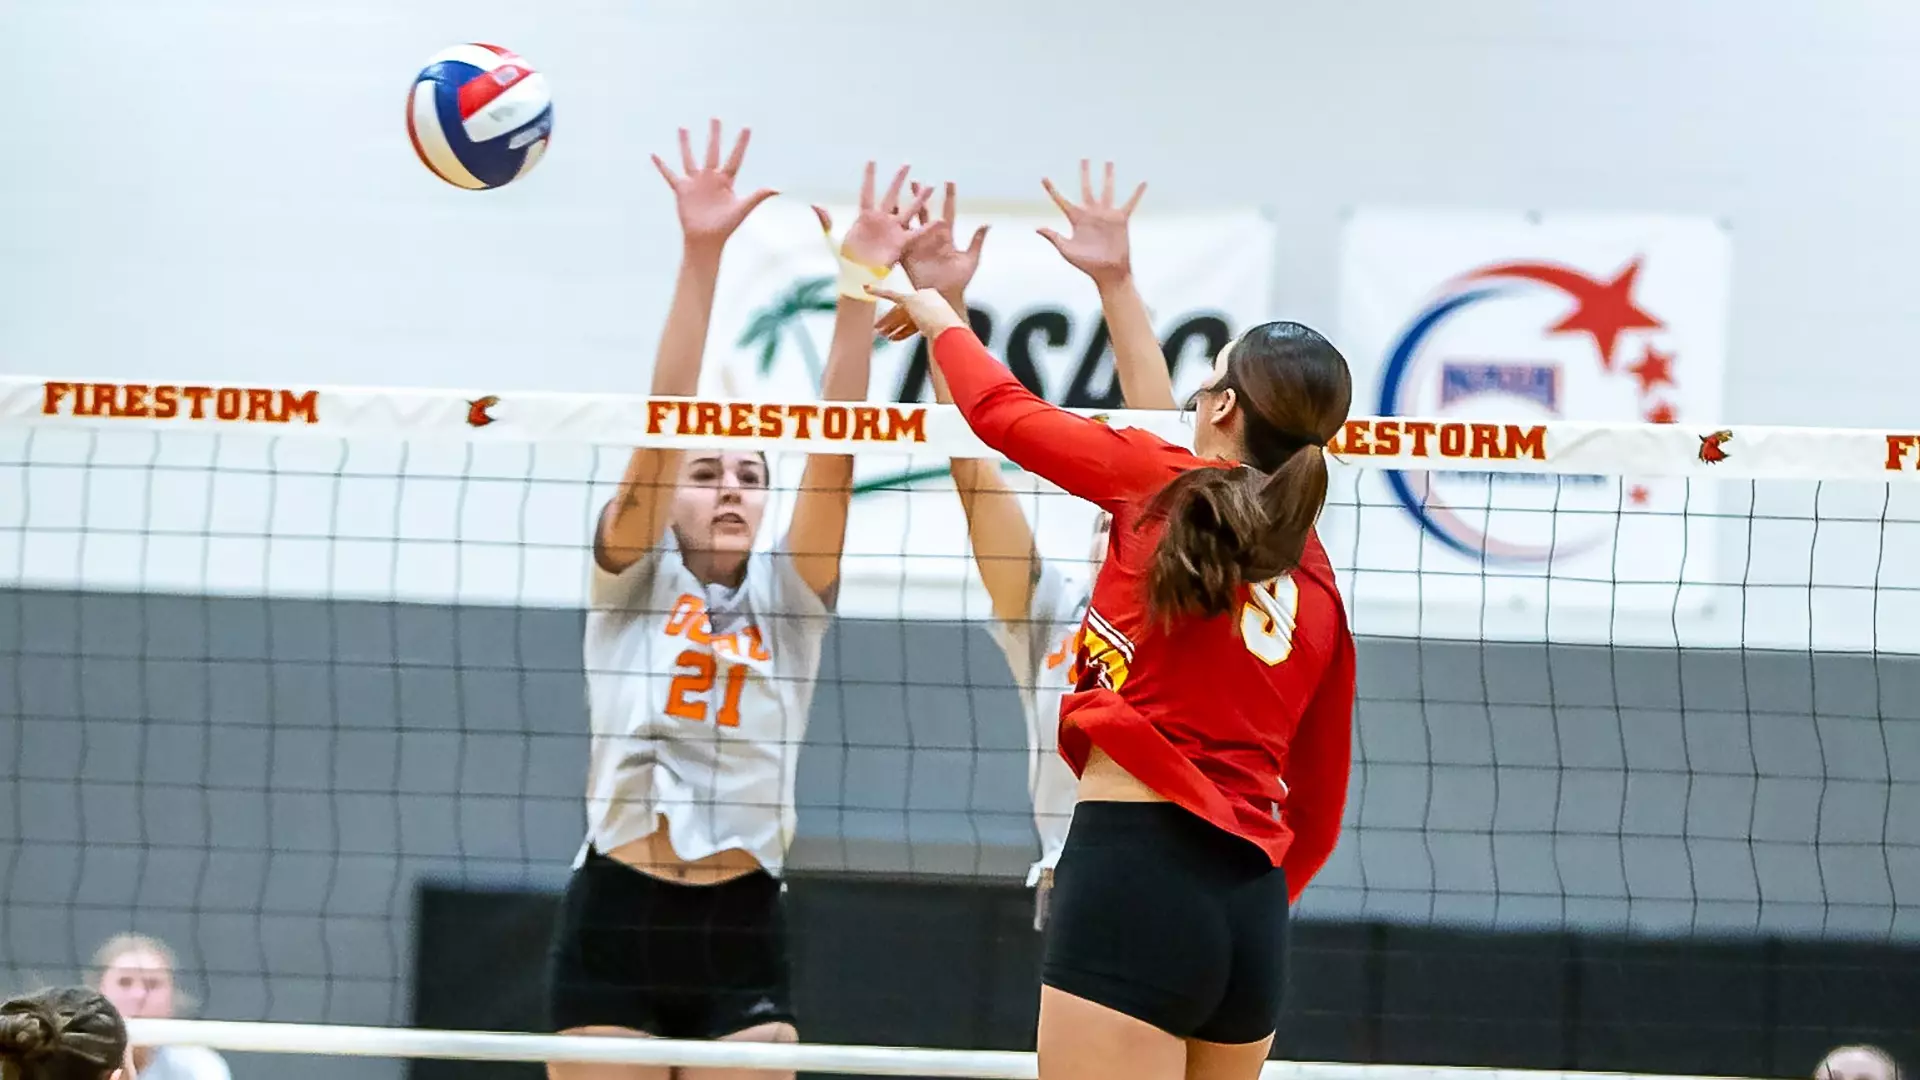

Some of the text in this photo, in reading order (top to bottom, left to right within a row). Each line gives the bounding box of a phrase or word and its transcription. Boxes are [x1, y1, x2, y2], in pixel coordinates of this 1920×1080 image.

[43, 381, 319, 424] FIRESTORM
[646, 401, 928, 443] FIRESTORM
[664, 649, 748, 727] 21
